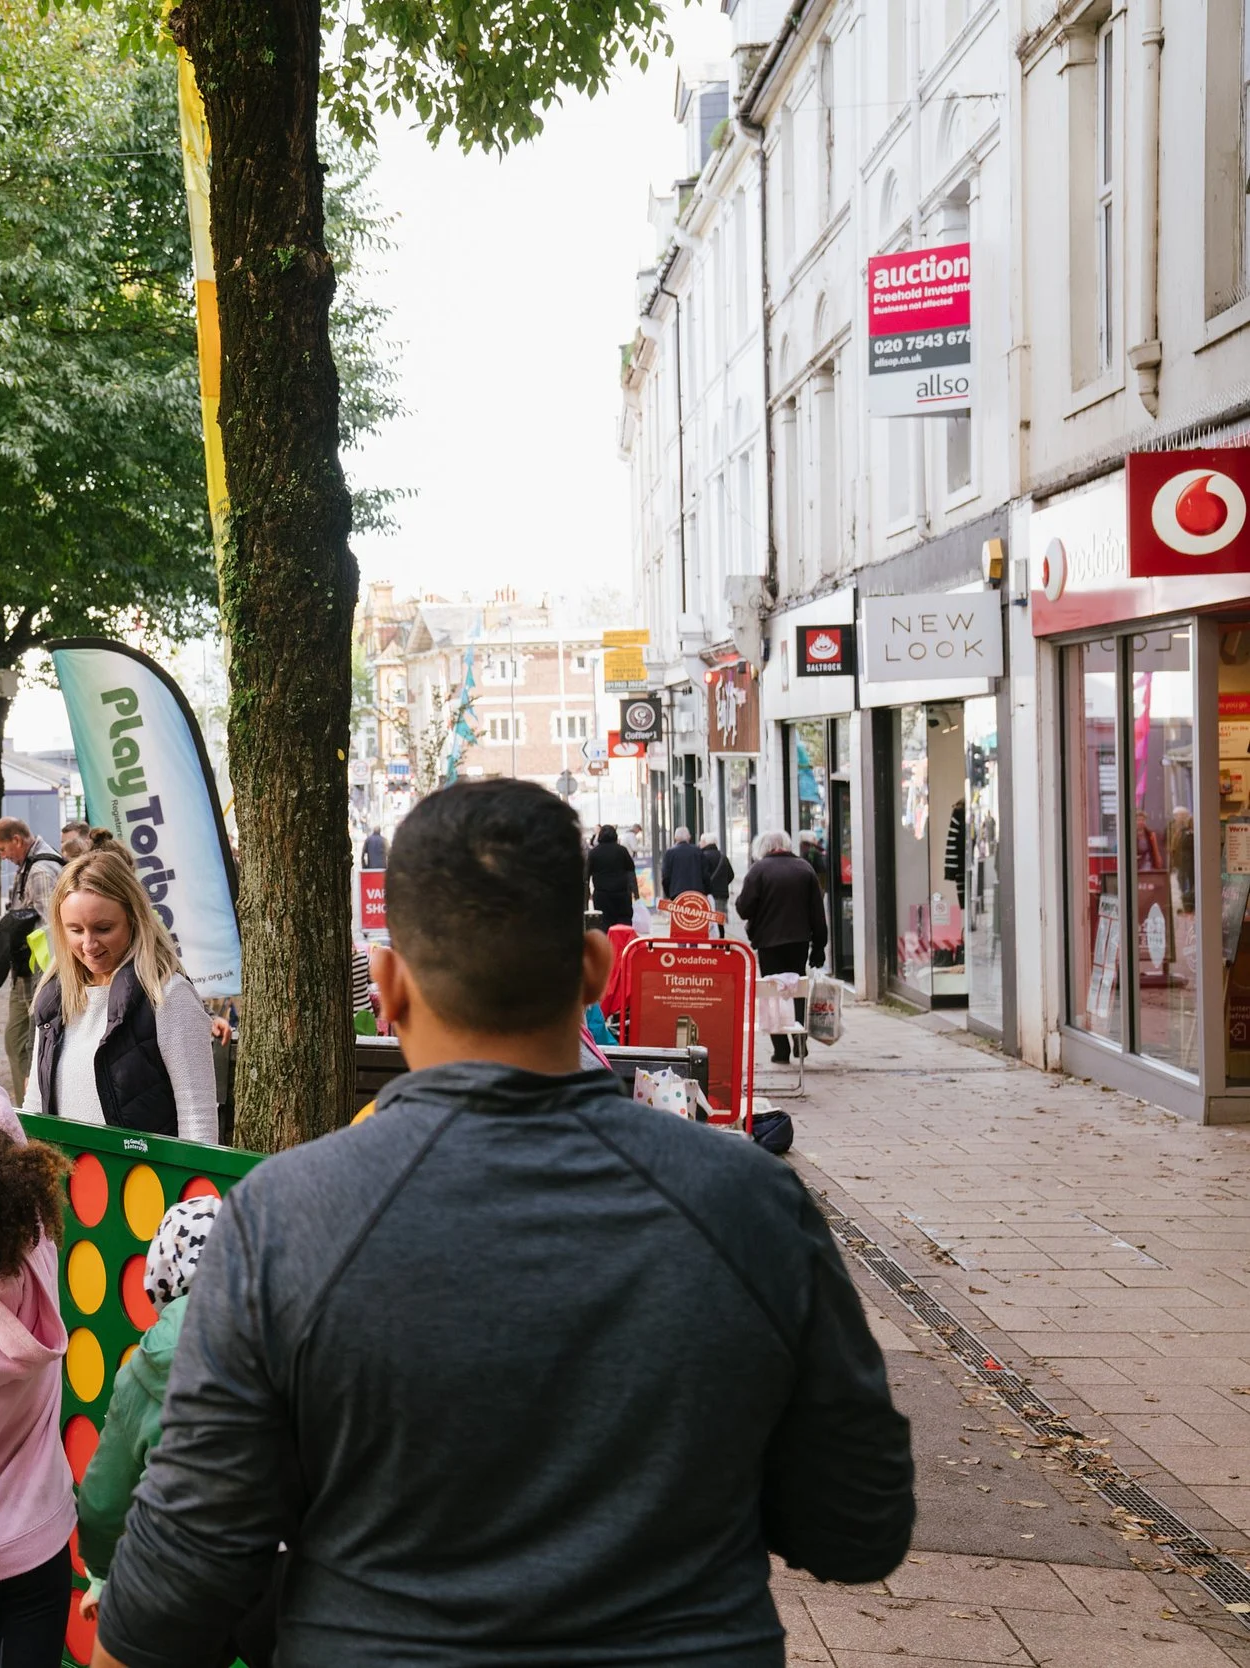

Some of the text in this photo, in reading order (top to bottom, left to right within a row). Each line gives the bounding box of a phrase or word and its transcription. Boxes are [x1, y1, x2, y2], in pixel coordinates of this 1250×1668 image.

[873, 254, 969, 289] auction
[873, 287, 923, 304] Freehold
[873, 297, 953, 315] Business not affected
[874, 338, 903, 354] 020
[905, 333, 944, 351] 7543
[874, 353, 922, 368] allsop.co.uk
[916, 373, 969, 398] allso
[892, 612, 974, 634] NEW
[885, 638, 984, 662] LOOK
[100, 687, 148, 798] Play
[125, 794, 183, 958] Torb
[667, 903, 718, 921] GUARANTEE
[677, 956, 718, 966] vodafone
[663, 974, 714, 987] Titanium
